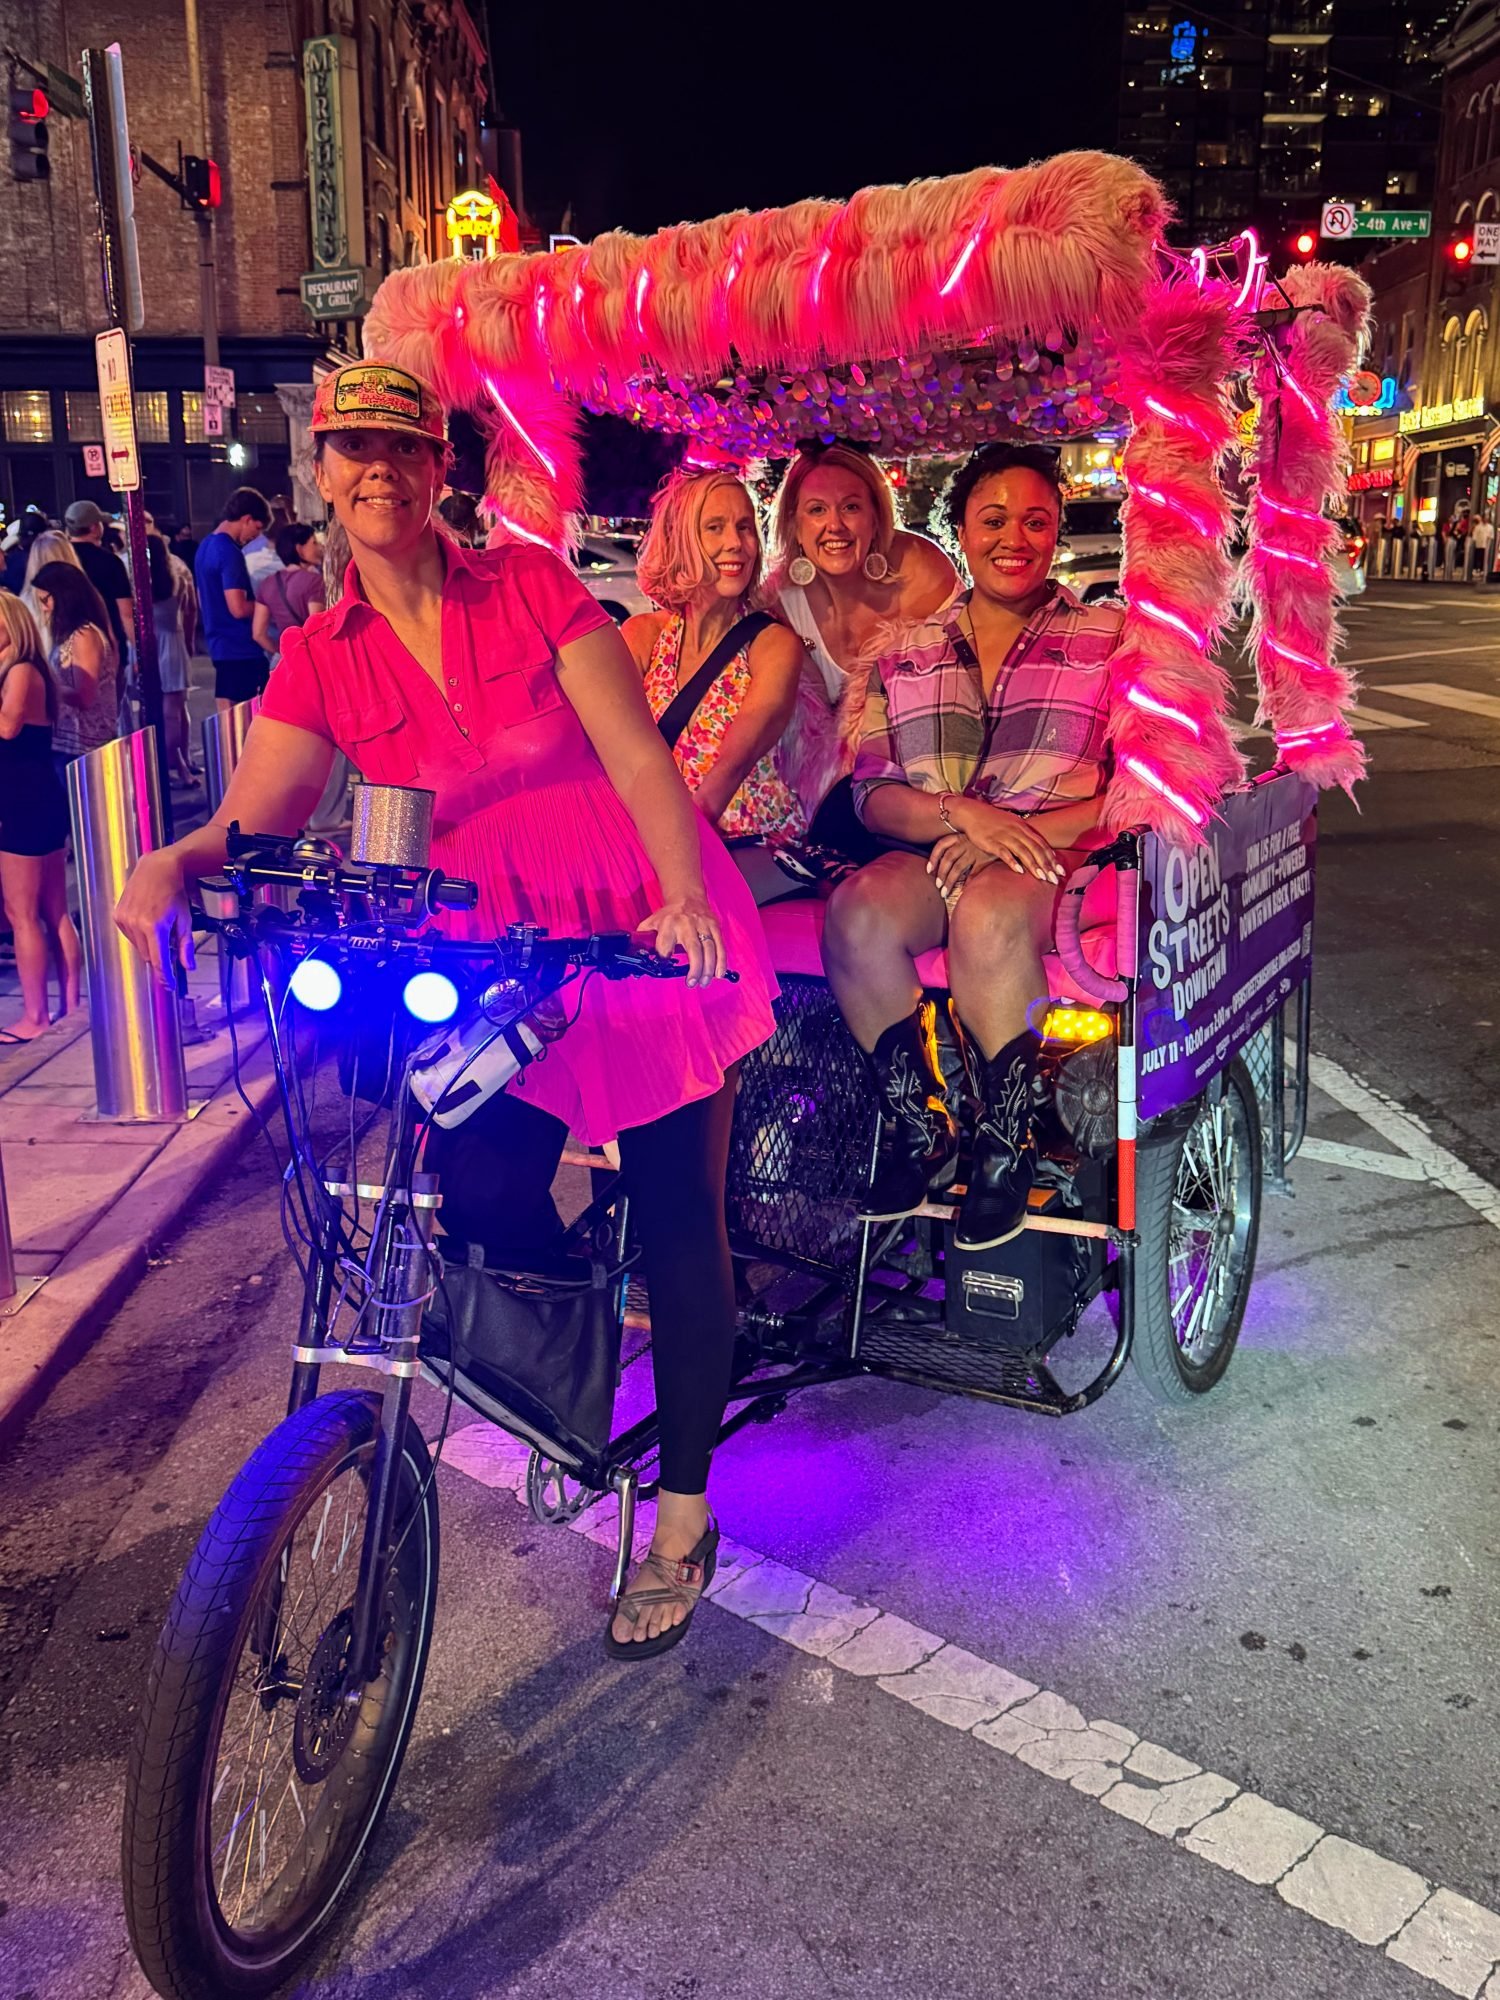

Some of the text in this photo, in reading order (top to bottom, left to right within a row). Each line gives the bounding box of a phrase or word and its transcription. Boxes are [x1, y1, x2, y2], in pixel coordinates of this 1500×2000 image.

[309, 49, 335, 262] MERCHANTS
[1352, 217, 1427, 231] S-4th Ave-N
[1477, 237, 1499, 248] WAY
[1478, 226, 1500, 236] ONE
[308, 279, 358, 296] RESTAURANT
[328, 293, 352, 307] GRILL
[1165, 832, 1221, 923] OPEN
[1241, 844, 1307, 908] COMMUNITY-POWERED
[1245, 841, 1260, 874] JOIN
[1260, 836, 1269, 864] US
[1270, 829, 1282, 858] FOR
[1287, 819, 1301, 849] FREE
[1148, 883, 1230, 990] STREETS
[1239, 868, 1311, 942] DOWNTOWN BLOCK PARTY!
[1172, 943, 1227, 1022] DOWNTOWN
[1141, 1045, 1166, 1076] JULY
[1168, 1040, 1178, 1064] 11
[1185, 1025, 1204, 1057] 10:00
[1214, 1006, 1225, 1033] 2:00
